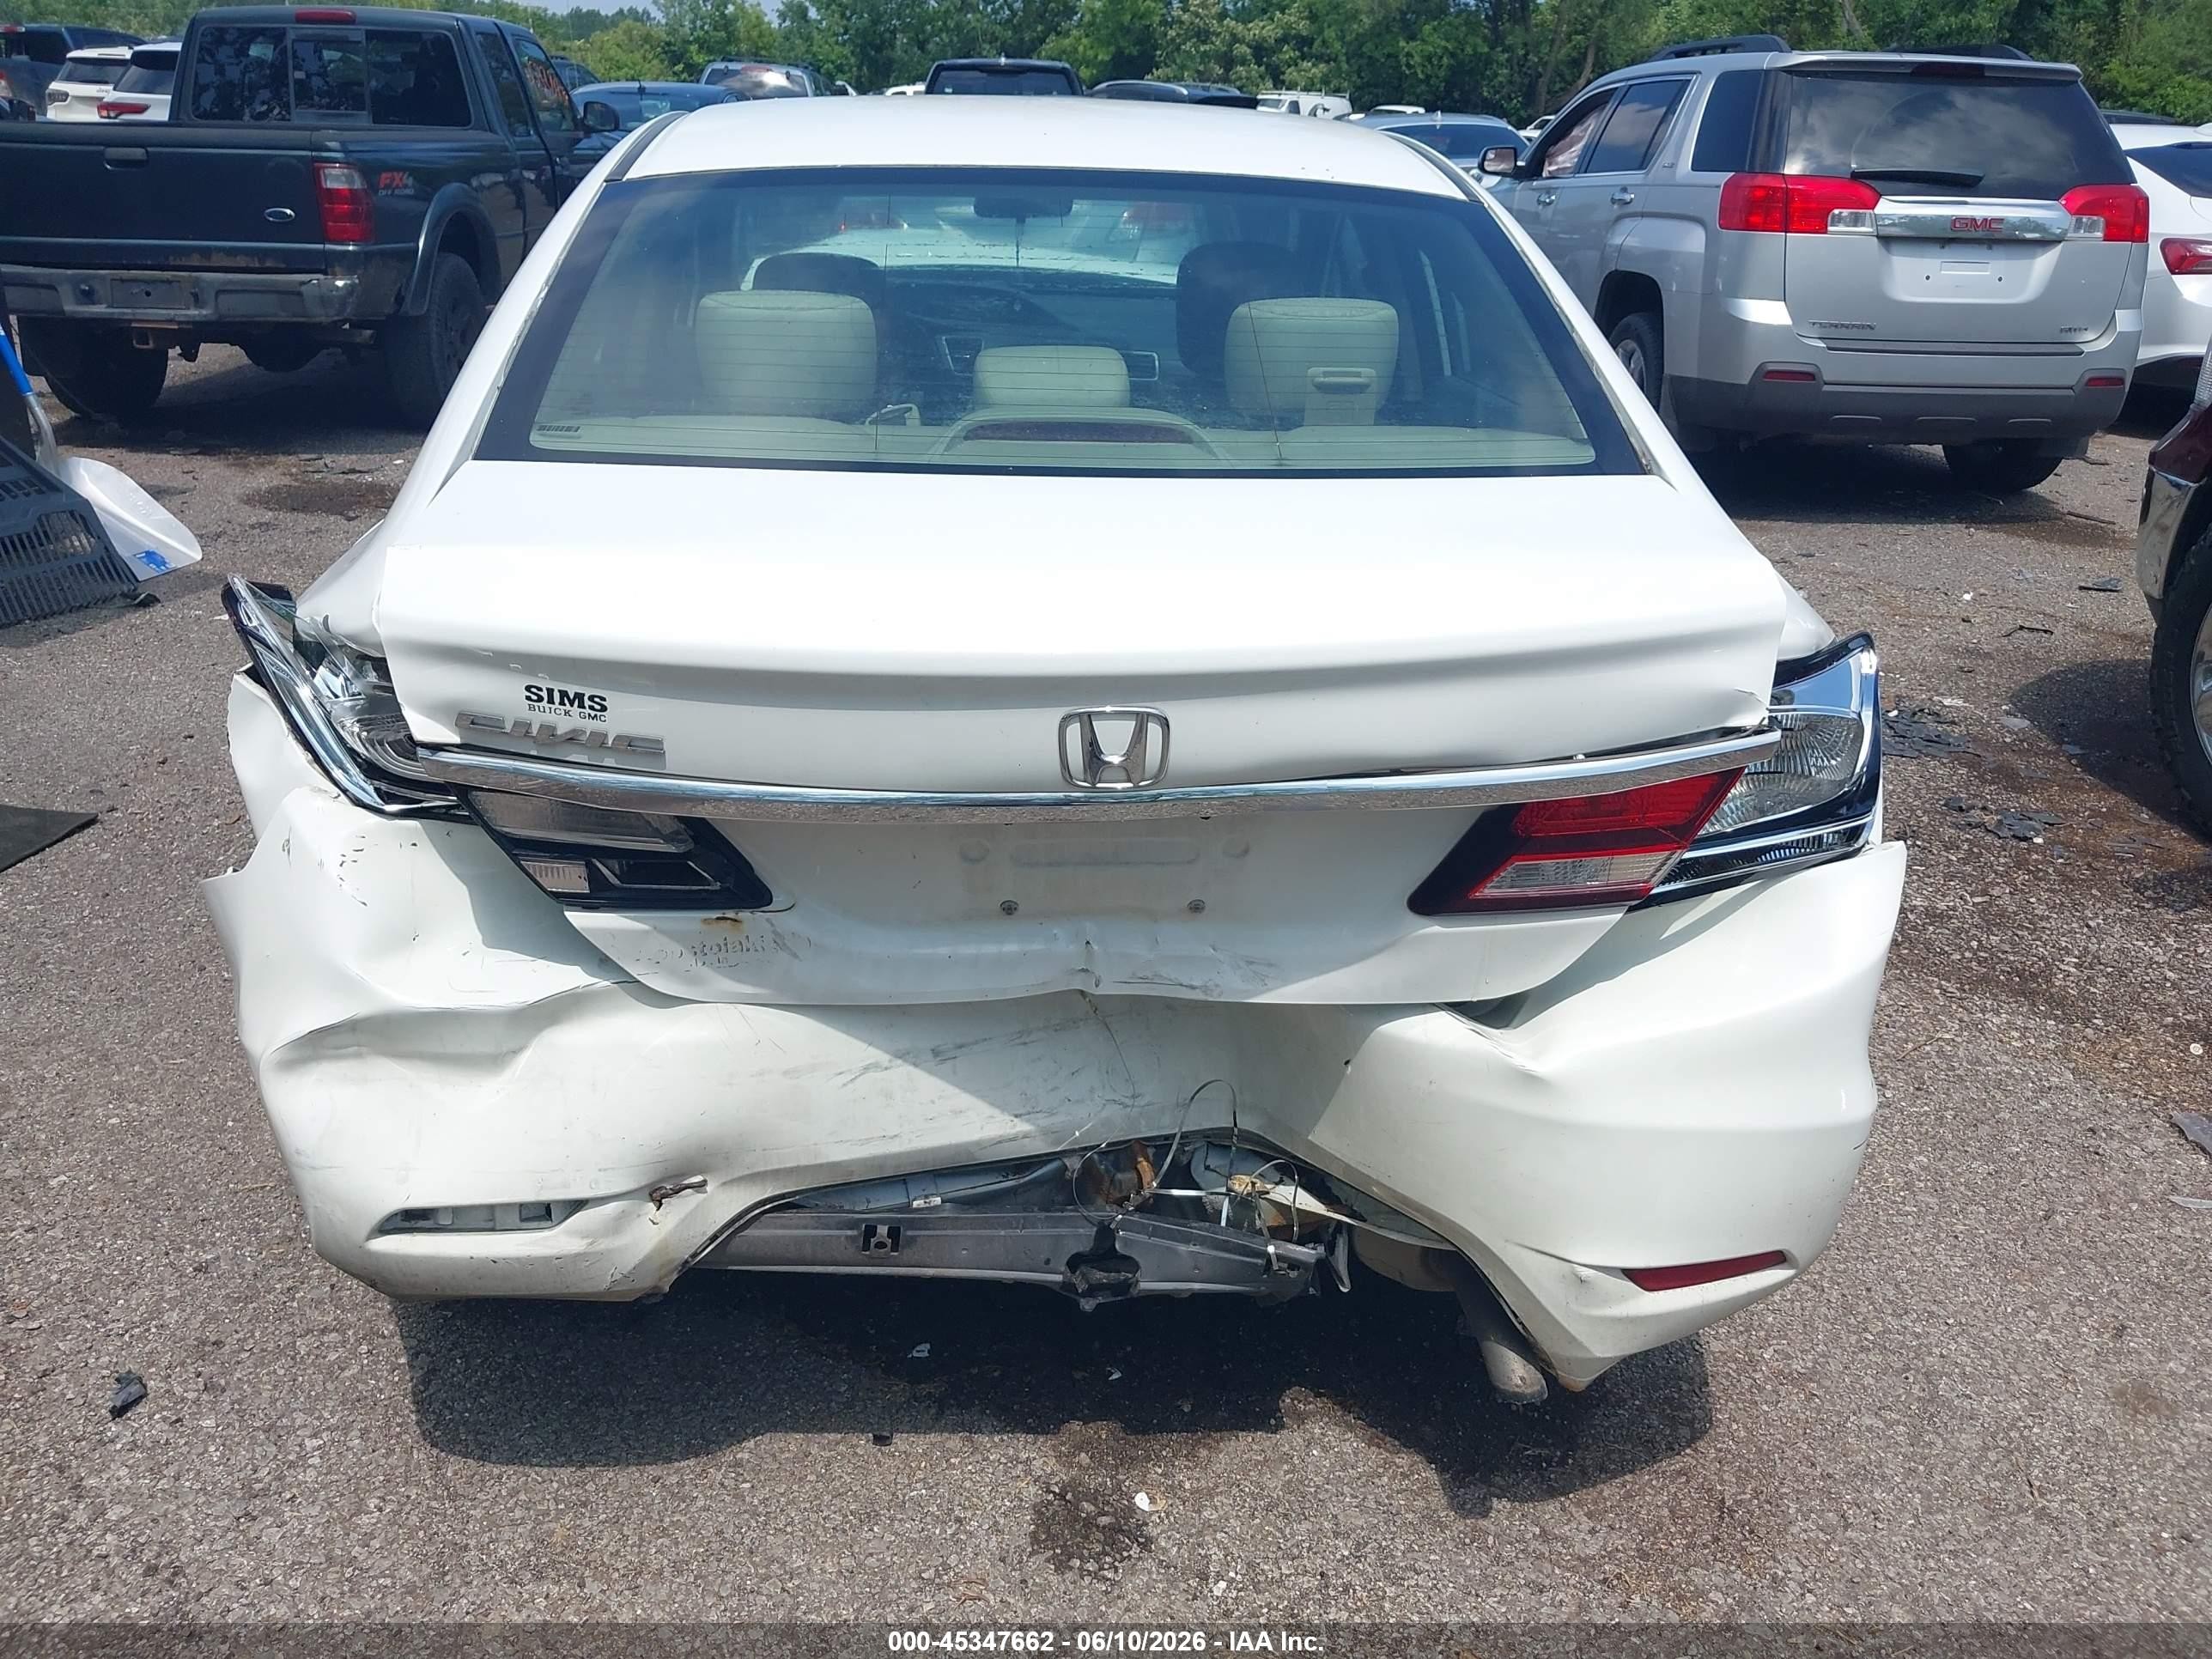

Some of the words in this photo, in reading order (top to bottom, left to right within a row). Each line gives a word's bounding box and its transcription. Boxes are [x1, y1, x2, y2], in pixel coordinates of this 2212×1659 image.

[379, 171, 413, 188] FX4
[1950, 216, 2005, 232] GMC
[524, 684, 609, 714] SIMS
[527, 702, 574, 718] BUICK
[578, 710, 607, 723] GMC
[454, 710, 665, 752] CIVIC
